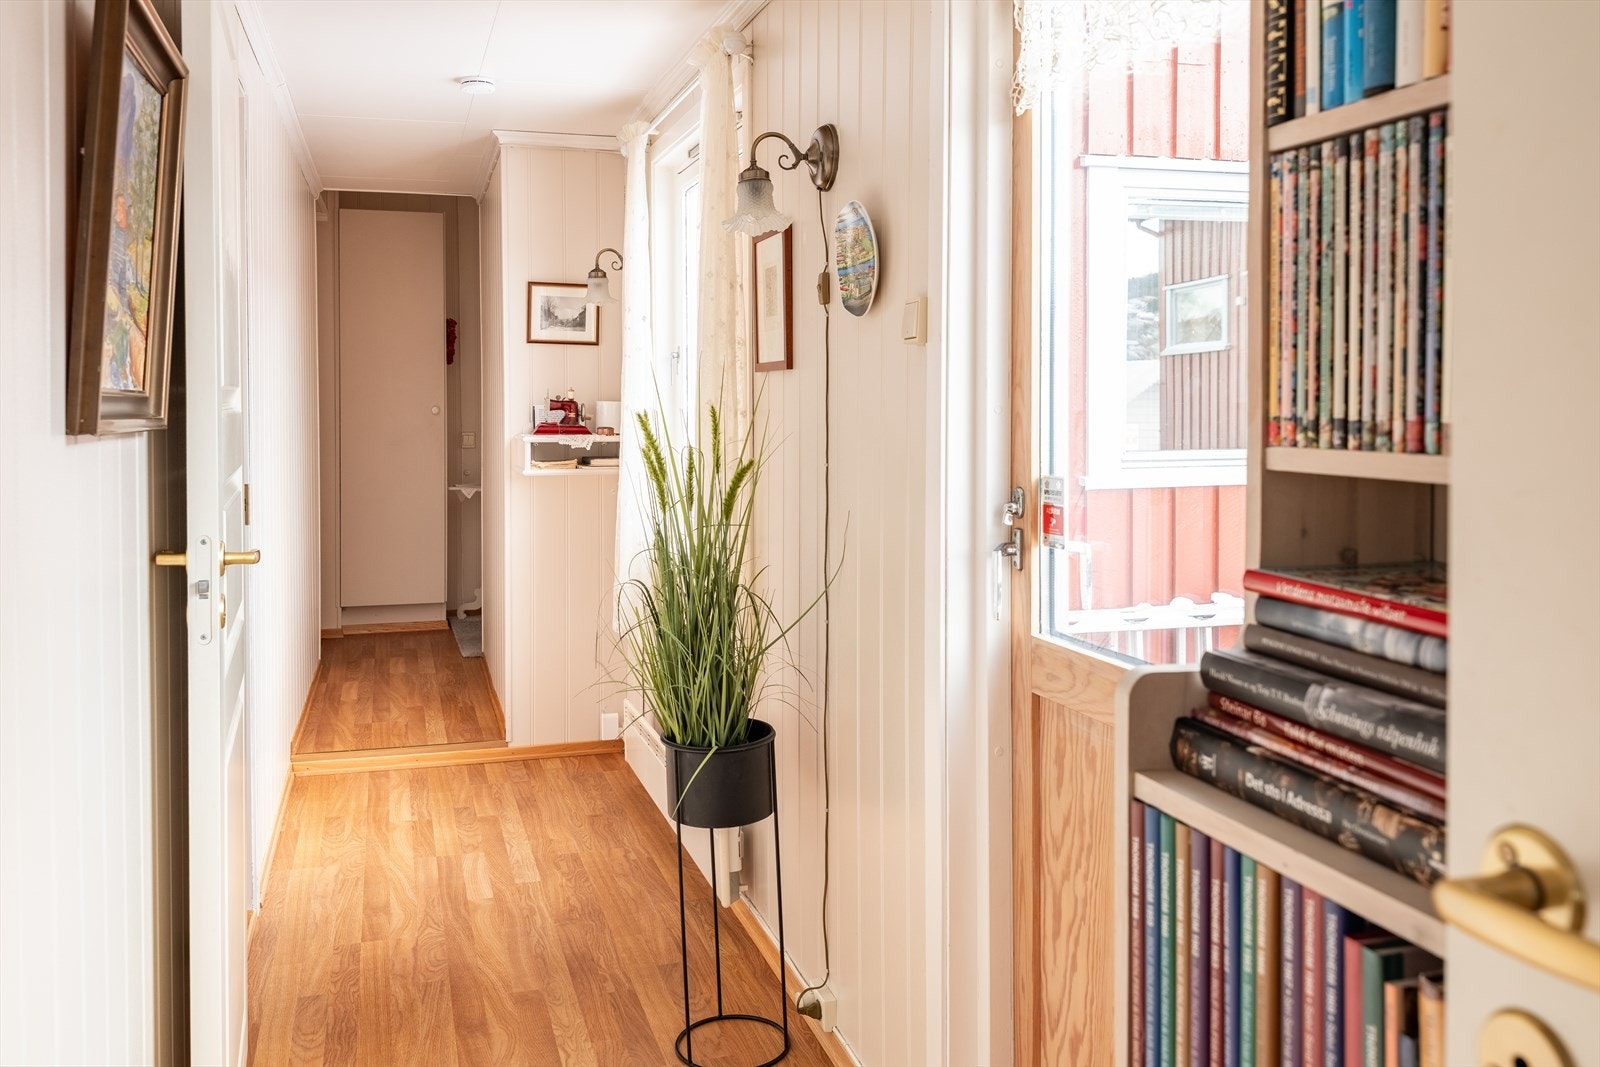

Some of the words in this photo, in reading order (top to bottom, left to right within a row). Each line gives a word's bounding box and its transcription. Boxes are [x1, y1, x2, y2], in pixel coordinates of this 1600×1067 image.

[1245, 770, 1263, 792] Det
[1263, 782, 1280, 801] sto
[1286, 788, 1332, 824] Adressa
[1132, 836, 1141, 895] TRONDHEIM
[1147, 842, 1155, 902] TRONDHEIM
[1161, 852, 1170, 912] TRONDHEIM
[1176, 858, 1184, 920] TRONDHEIM
[1192, 869, 1200, 932] TRONDHEIM
[1211, 879, 1220, 943] TRONDHEIM
[1242, 876, 1253, 945] TRONDHEIM
[1258, 879, 1267, 947] TRONDHEIM
[1284, 888, 1295, 959] TRONDHEIM
[1305, 898, 1315, 968] TRONDHEIM
[1326, 913, 1338, 985] TRONDHEIM
[1284, 961, 1295, 988] 1967
